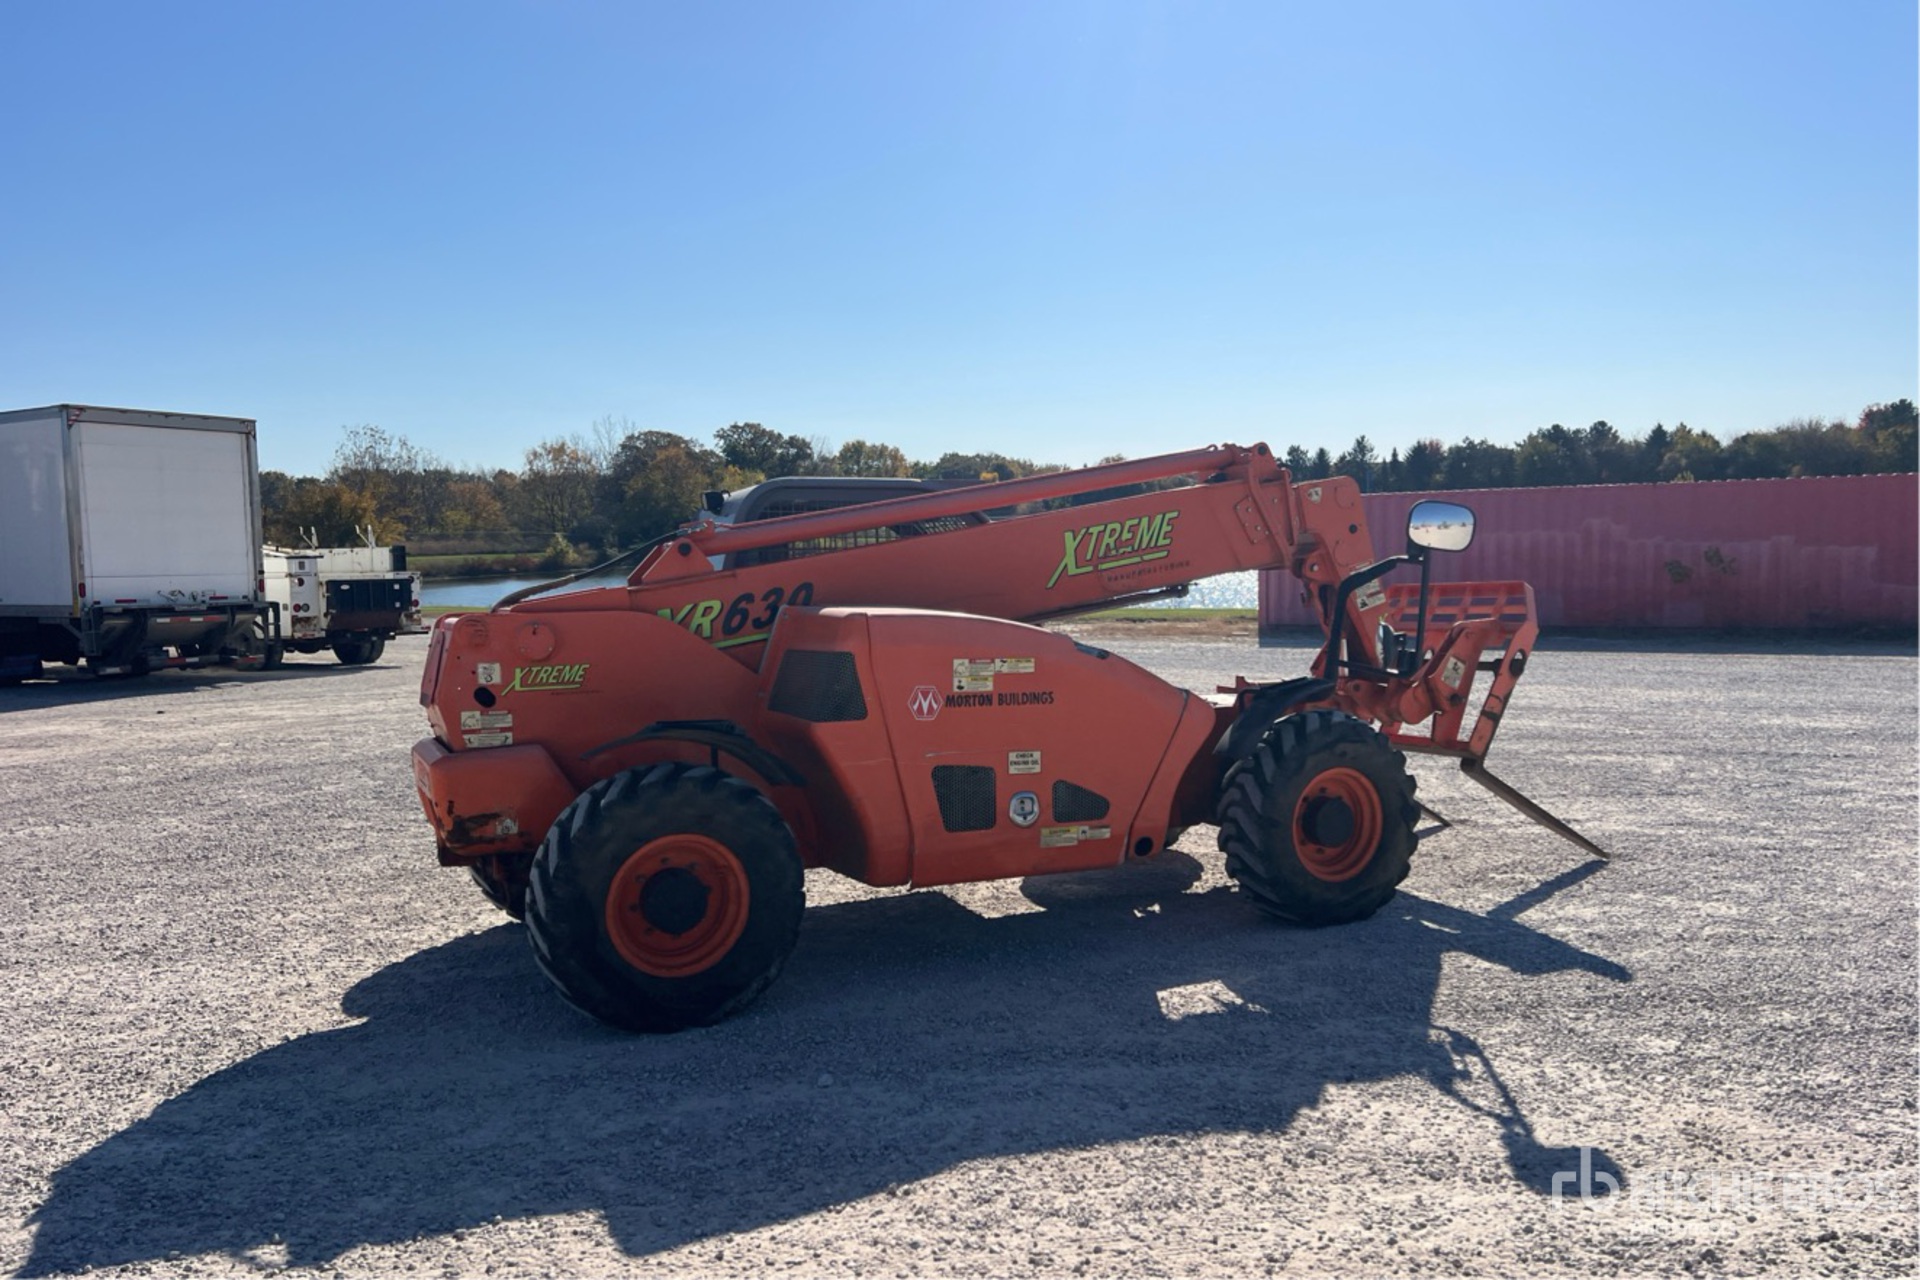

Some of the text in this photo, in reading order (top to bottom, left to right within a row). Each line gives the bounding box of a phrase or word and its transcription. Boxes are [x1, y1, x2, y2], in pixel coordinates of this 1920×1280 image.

[1045, 510, 1180, 589] XTREME
[501, 663, 590, 696] XTREME
[945, 691, 1055, 708] MORTON BUILDINGS
